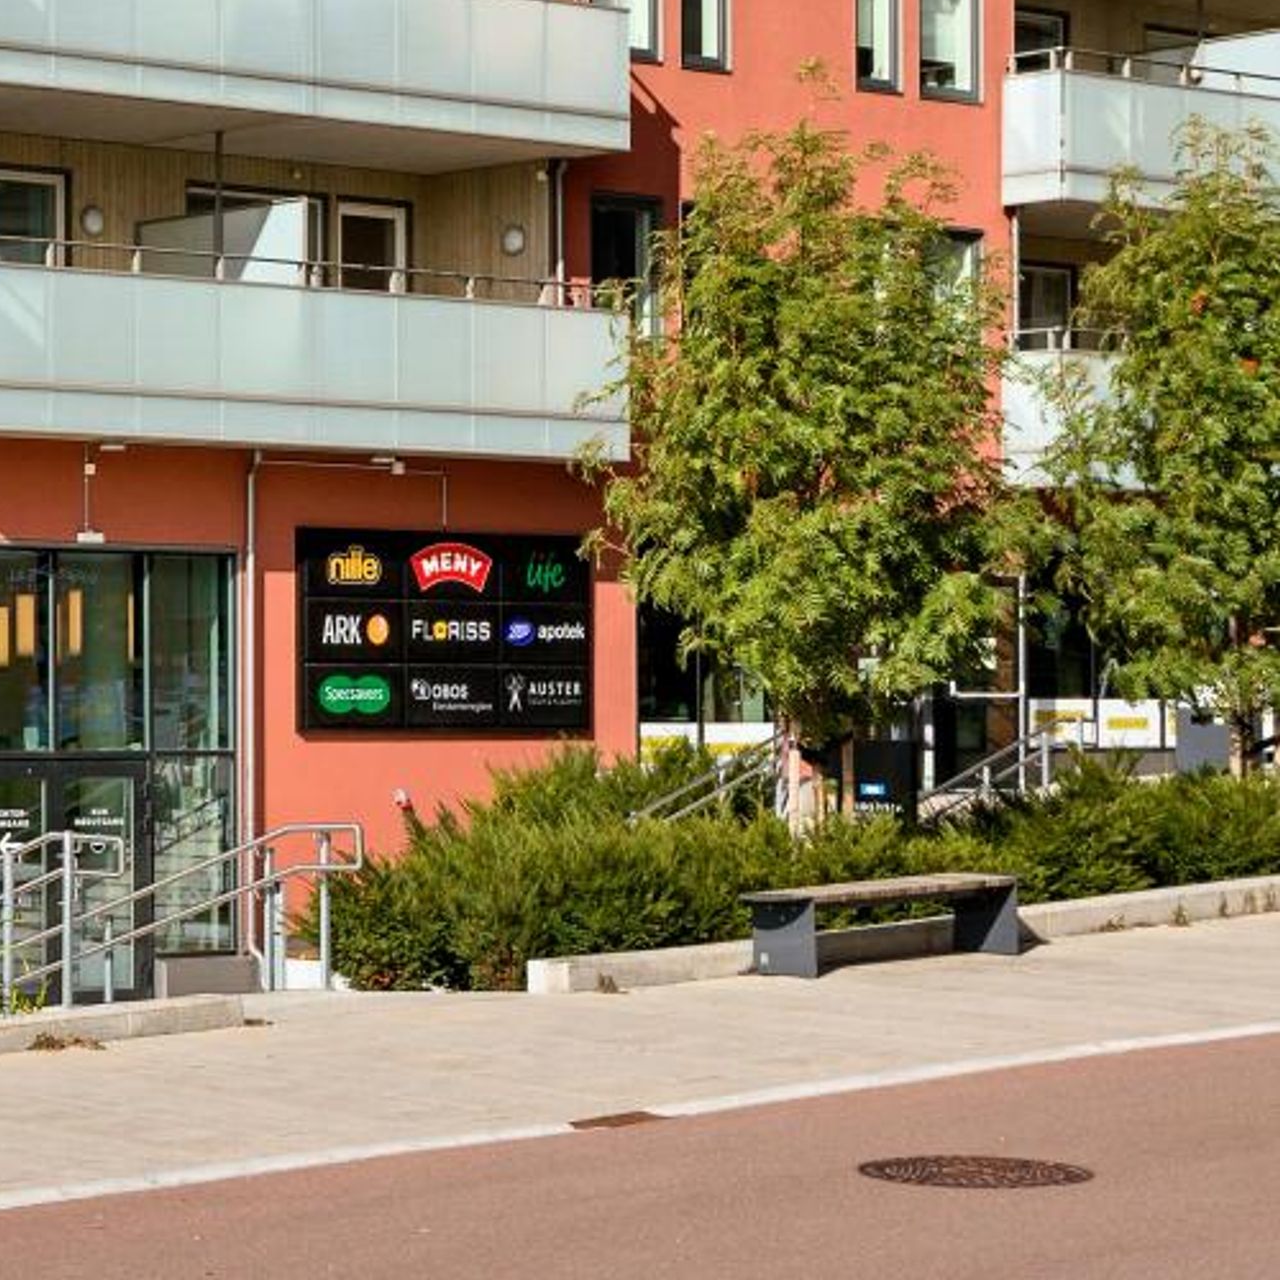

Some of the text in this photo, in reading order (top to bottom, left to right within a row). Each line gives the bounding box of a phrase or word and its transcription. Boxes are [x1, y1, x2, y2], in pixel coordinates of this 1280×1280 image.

[329, 548, 381, 583] nille
[421, 553, 483, 578] MENY
[526, 551, 566, 592] life
[322, 615, 362, 645] ARK
[412, 620, 491, 641] FLORISS
[537, 622, 585, 641] apotek
[325, 686, 384, 702] Specsavers
[432, 683, 469, 699] OBOS
[528, 681, 582, 696] AUSTER
